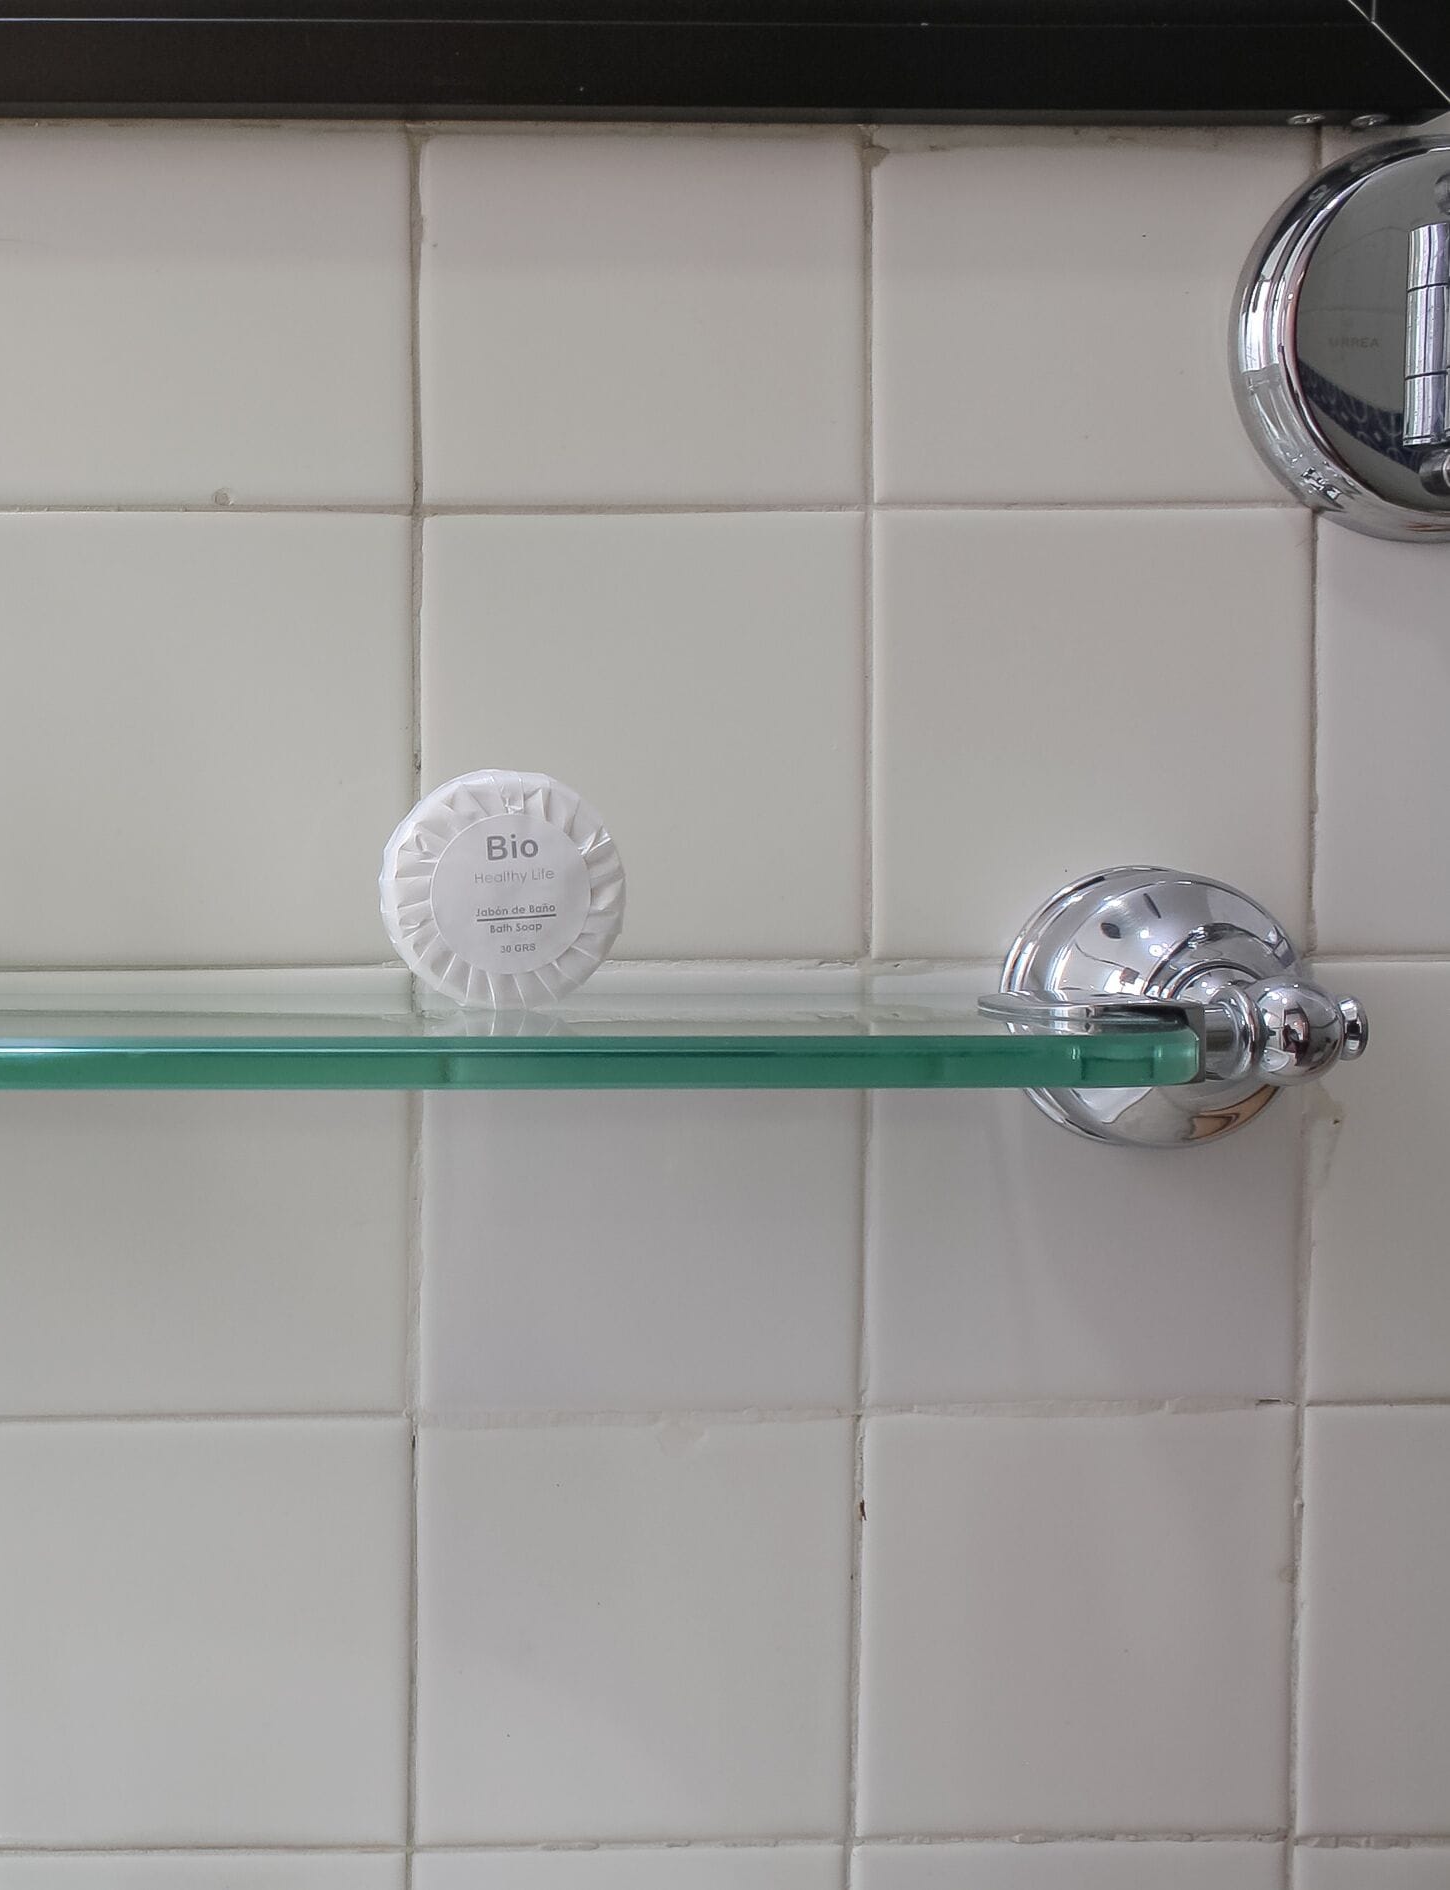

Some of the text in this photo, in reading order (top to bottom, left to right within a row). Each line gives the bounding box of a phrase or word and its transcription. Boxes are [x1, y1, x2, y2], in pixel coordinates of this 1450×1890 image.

[486, 834, 538, 861] Bio
[474, 868, 555, 885] Healthy Life
[476, 903, 556, 917] Jabón de Baño
[489, 922, 542, 934] Bath Soap
[500, 943, 536, 953] 30 GRS
